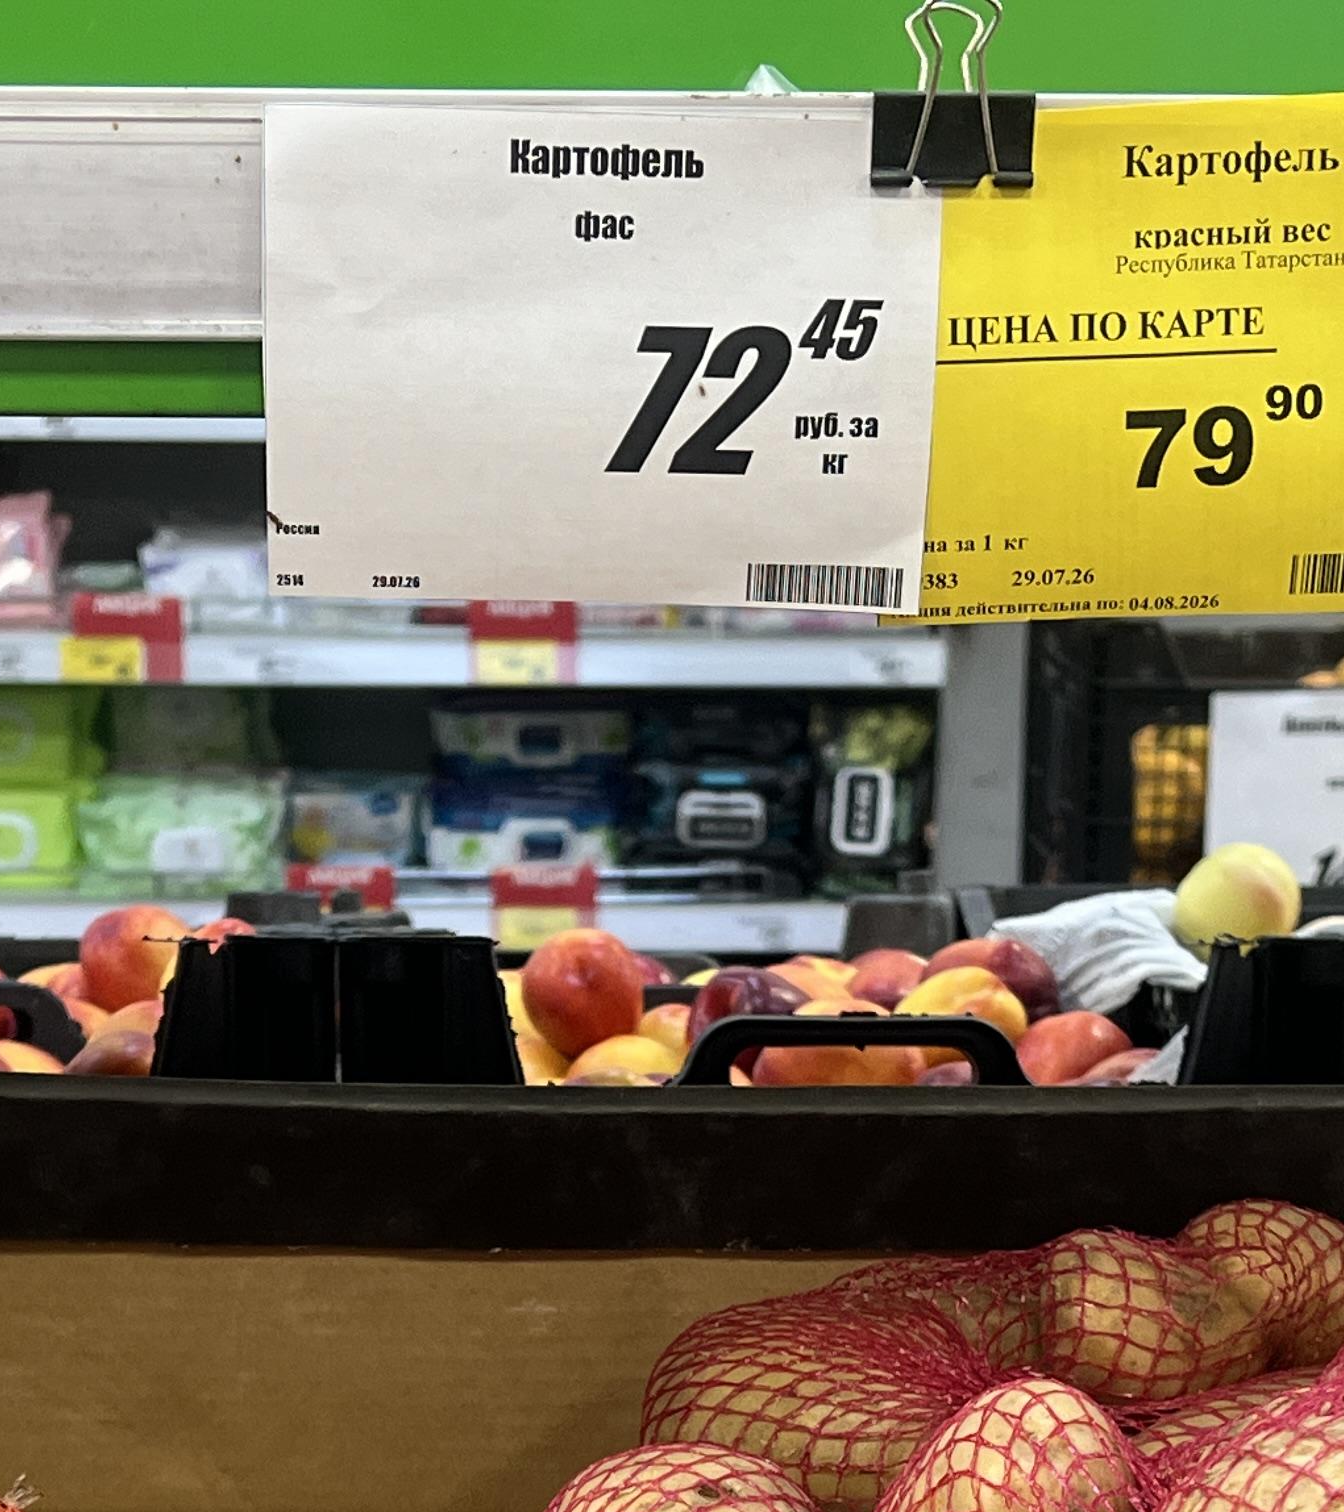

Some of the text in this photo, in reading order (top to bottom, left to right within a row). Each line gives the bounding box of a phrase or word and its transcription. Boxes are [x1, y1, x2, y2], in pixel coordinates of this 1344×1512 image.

[510, 138, 705, 181] Картофель
[1123, 140, 1340, 186] Картофель
[575, 210, 635, 243] фас
[1134, 217, 1331, 250] красный вес
[1115, 252, 1236, 279] Республика
[948, 306, 1264, 352] ЦЕНА ПО КАРТЕ
[603, 298, 885, 476] 72 45
[794, 412, 879, 440] руб. за
[1125, 383, 1323, 489] 79 90
[822, 453, 849, 475] кг
[276, 524, 320, 535] Россия
[923, 534, 1028, 554] на за 1 кг
[276, 573, 304, 587] 2514
[372, 575, 420, 589] 29.07.26
[920, 572, 959, 590] 383
[1011, 568, 1095, 587] 29.07.26
[918, 595, 1220, 618] ция действительна по: 04.08.2026
